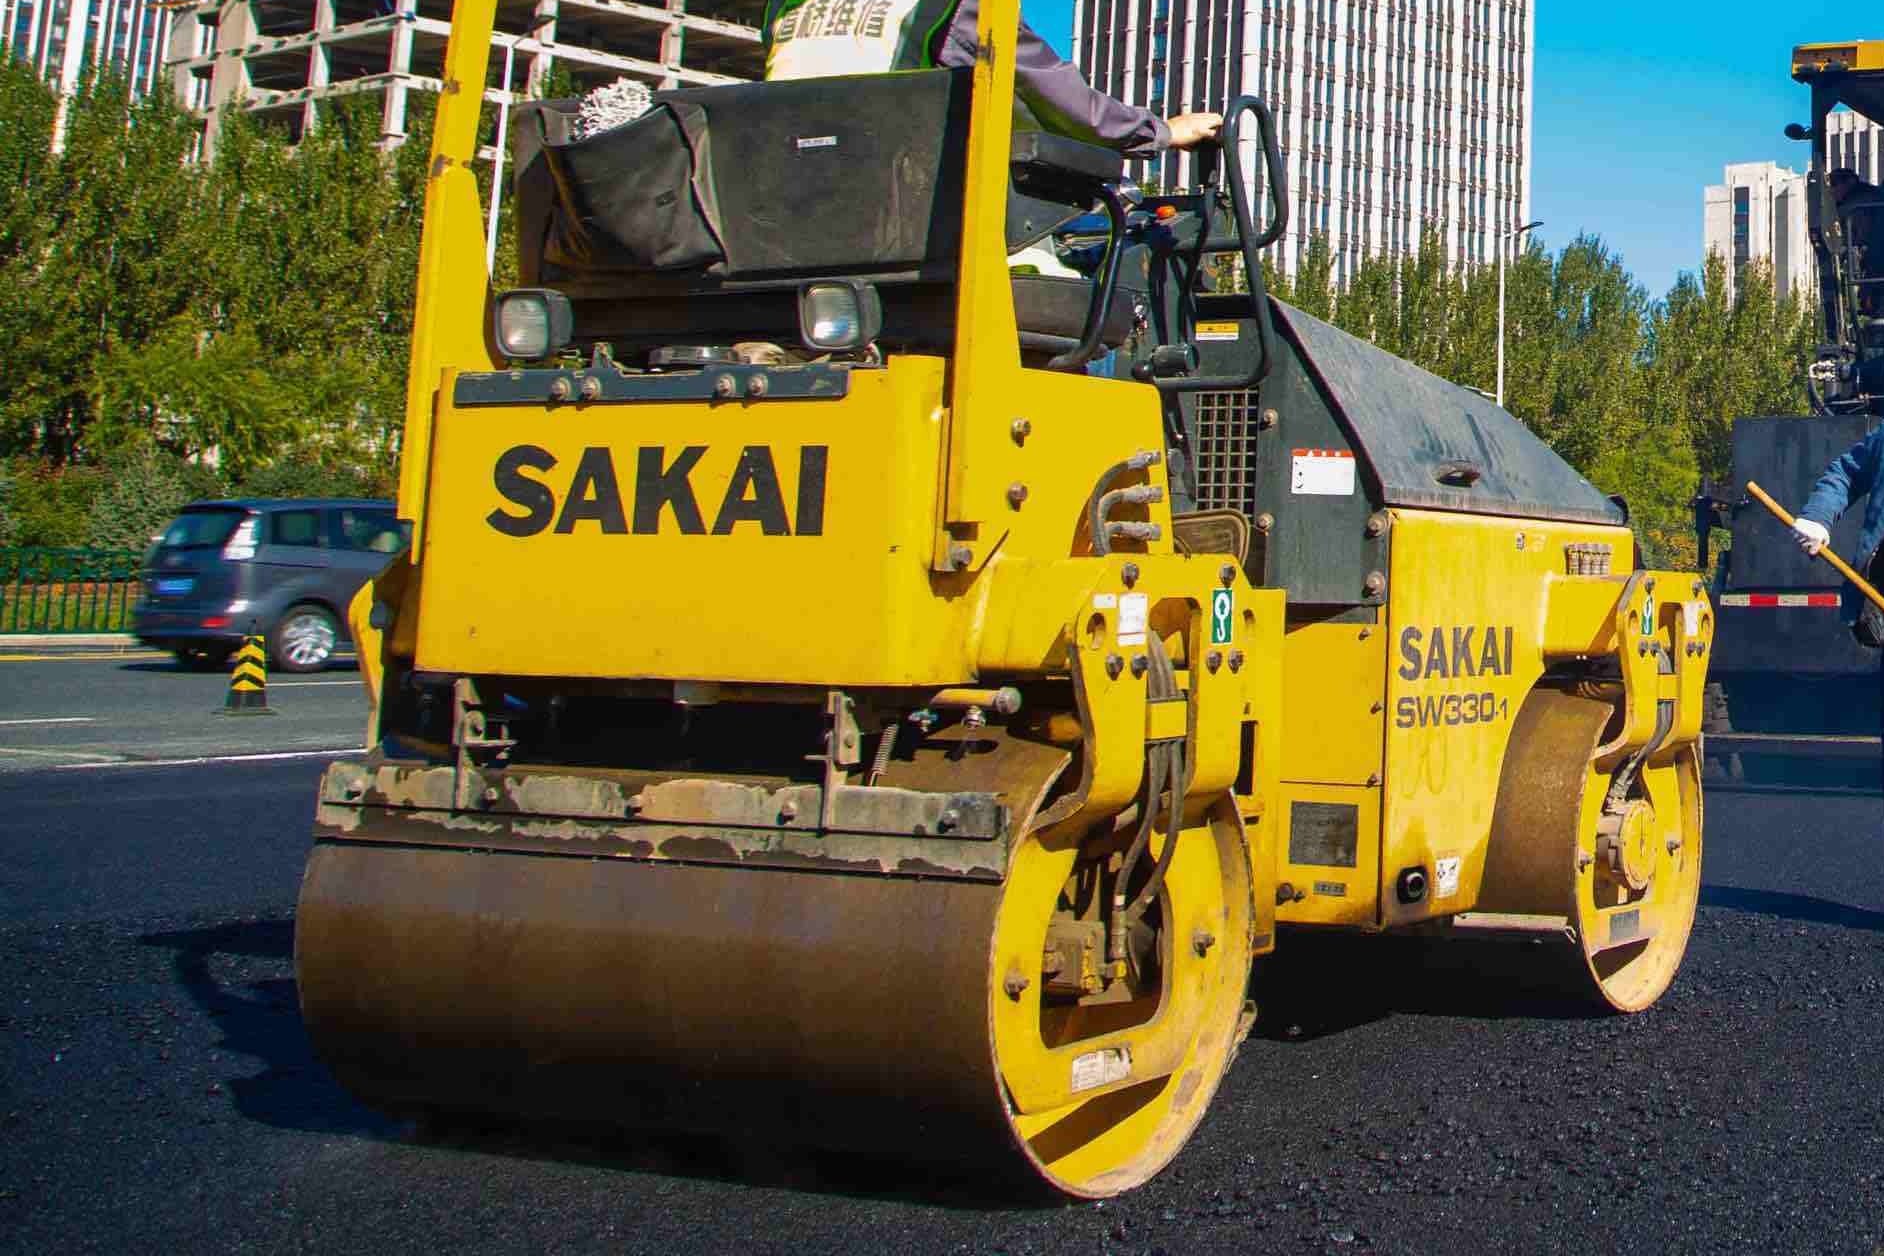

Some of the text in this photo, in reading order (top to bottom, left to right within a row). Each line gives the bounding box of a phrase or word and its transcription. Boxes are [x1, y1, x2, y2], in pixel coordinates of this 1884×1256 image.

[484, 444, 829, 538] SAKAI
[1398, 626, 1513, 681] SAKAI
[1395, 693, 1508, 728] SW330-1
